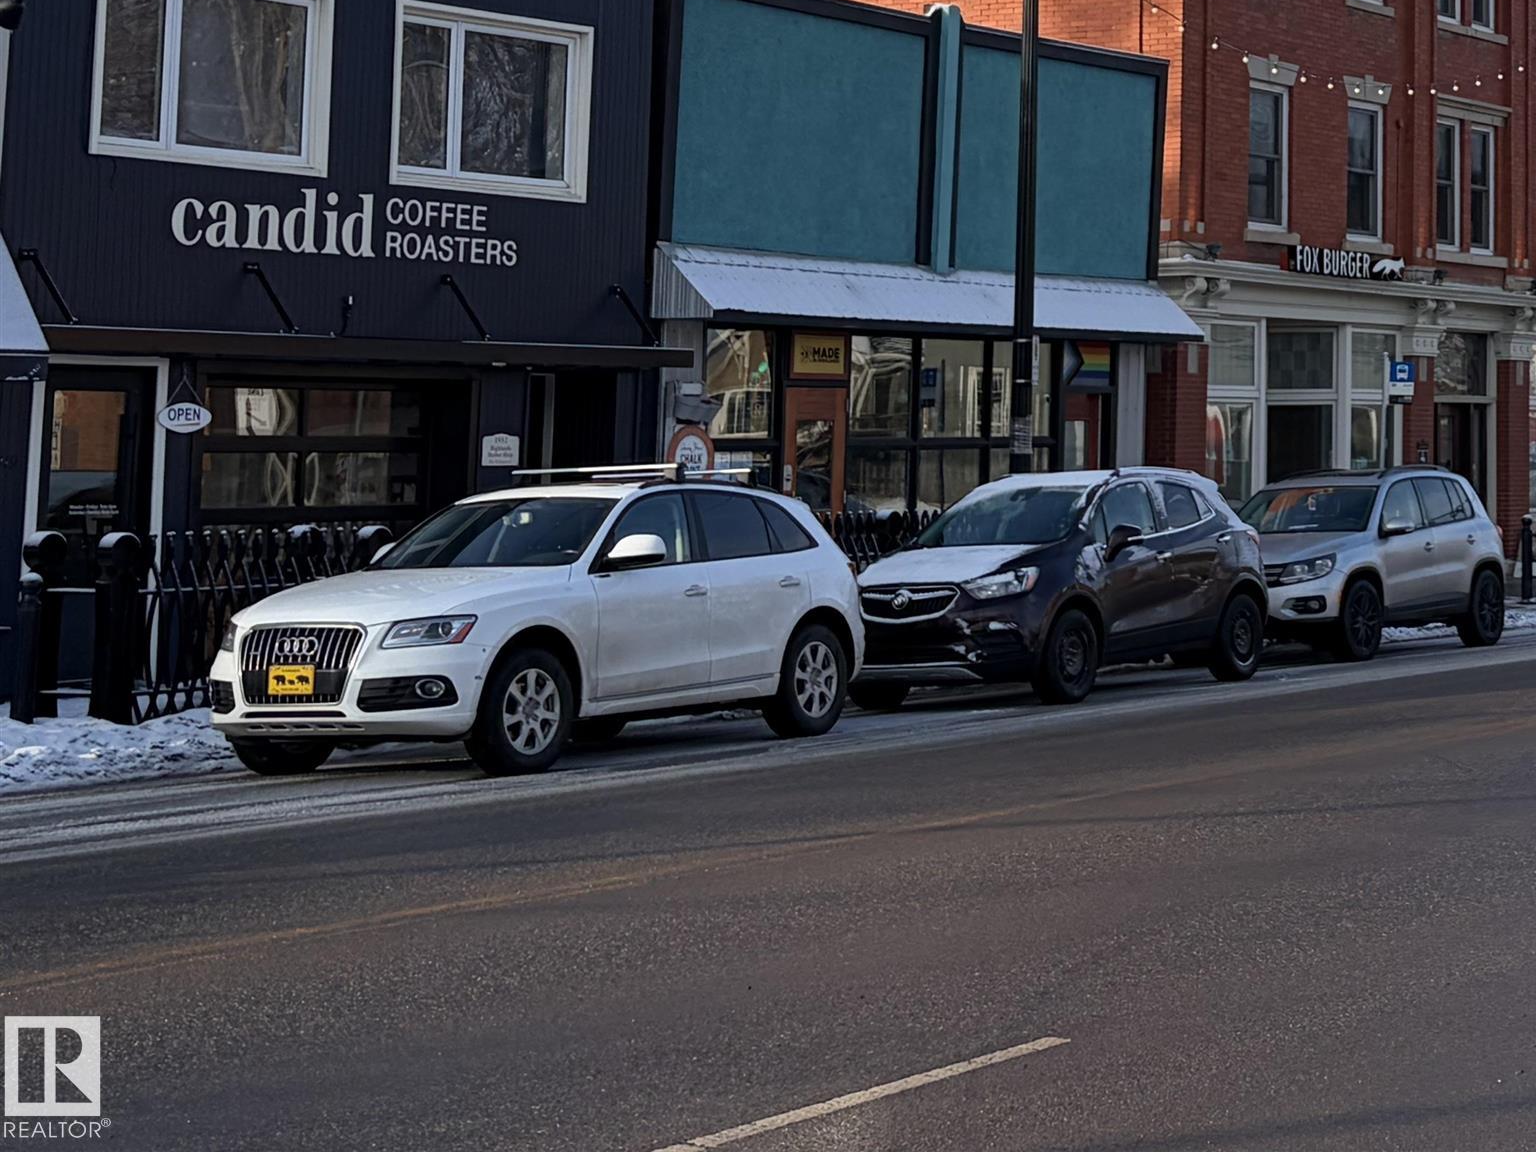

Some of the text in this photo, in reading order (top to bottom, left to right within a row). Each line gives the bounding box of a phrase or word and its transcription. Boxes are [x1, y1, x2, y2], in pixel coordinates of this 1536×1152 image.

[171, 188, 375, 258] candid
[385, 198, 488, 232] COFFEE
[384, 231, 517, 267] ROASTERS
[1296, 245, 1371, 279] FOX BURGER
[812, 347, 840, 358] MADE
[167, 407, 201, 422] OPEN
